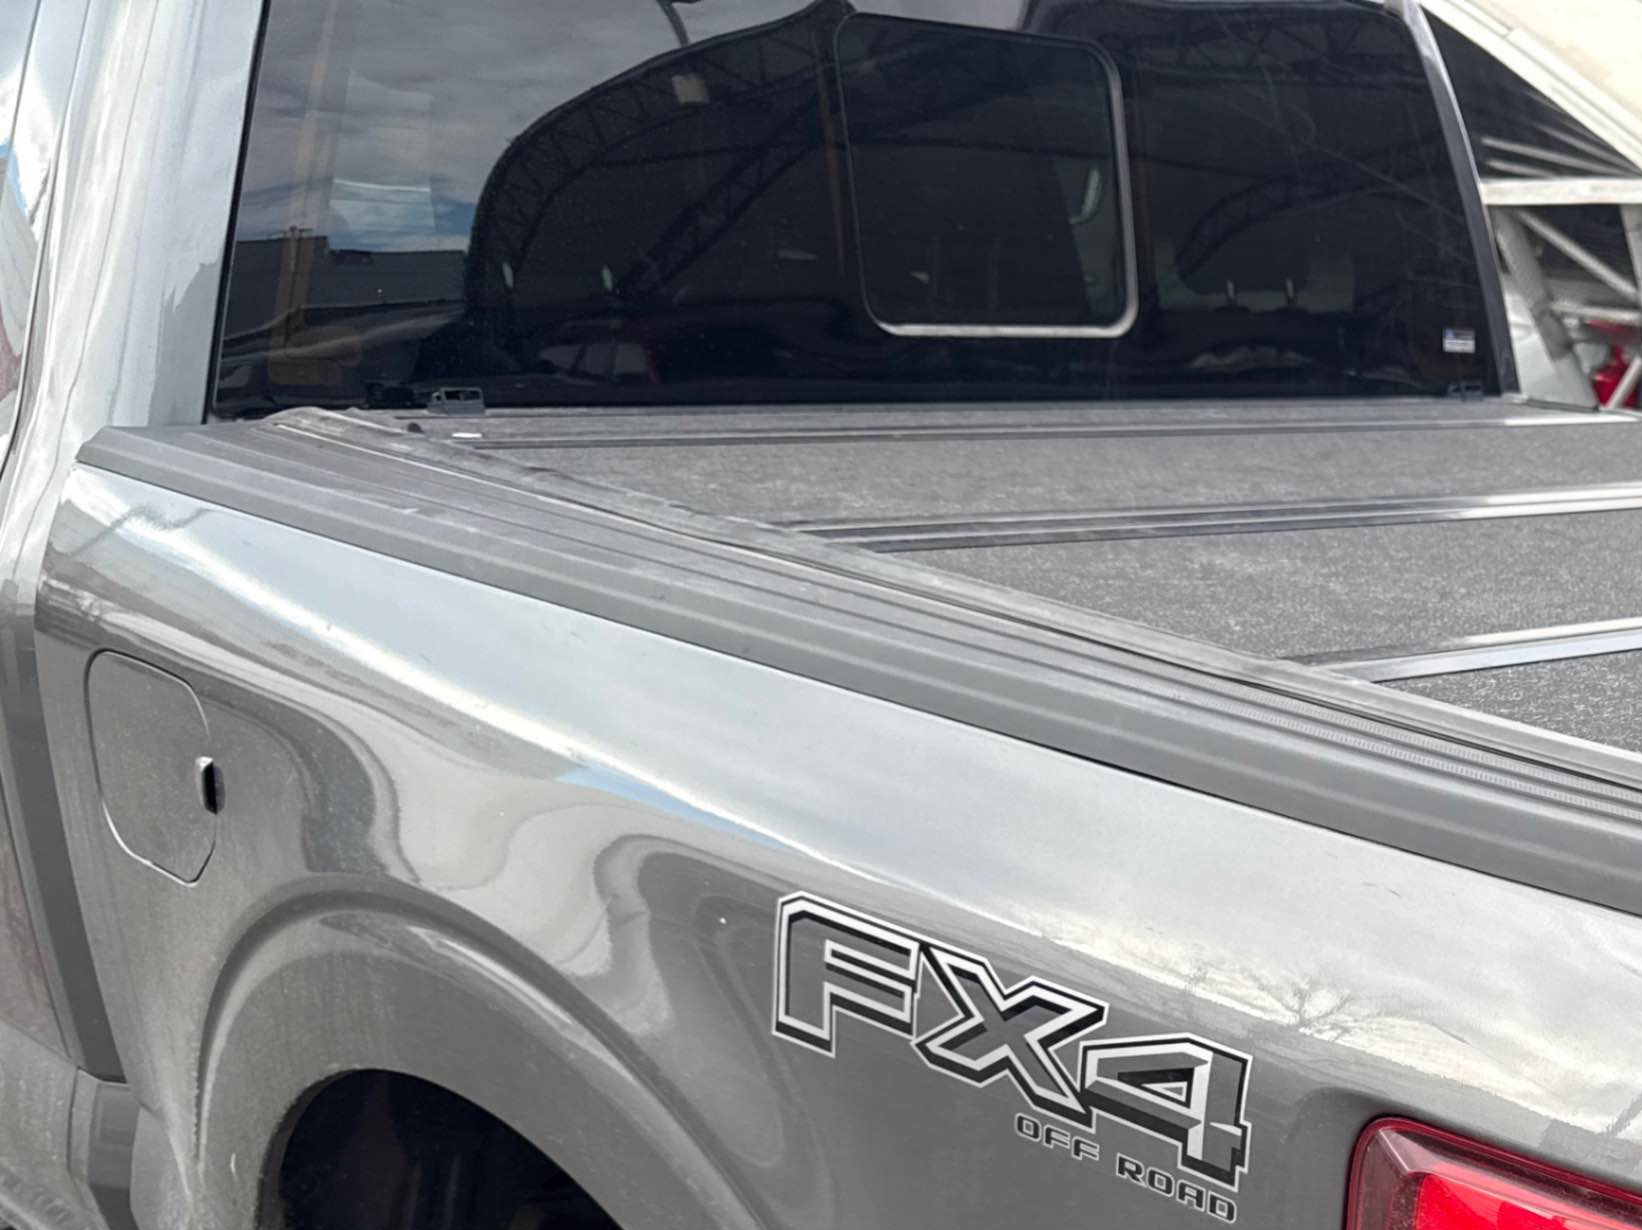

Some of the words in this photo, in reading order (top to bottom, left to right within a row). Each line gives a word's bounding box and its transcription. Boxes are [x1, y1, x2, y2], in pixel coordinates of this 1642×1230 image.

[773, 891, 1254, 1192] FX4
[1015, 1112, 1100, 1161] OFF
[1116, 1153, 1238, 1224] ROAD
